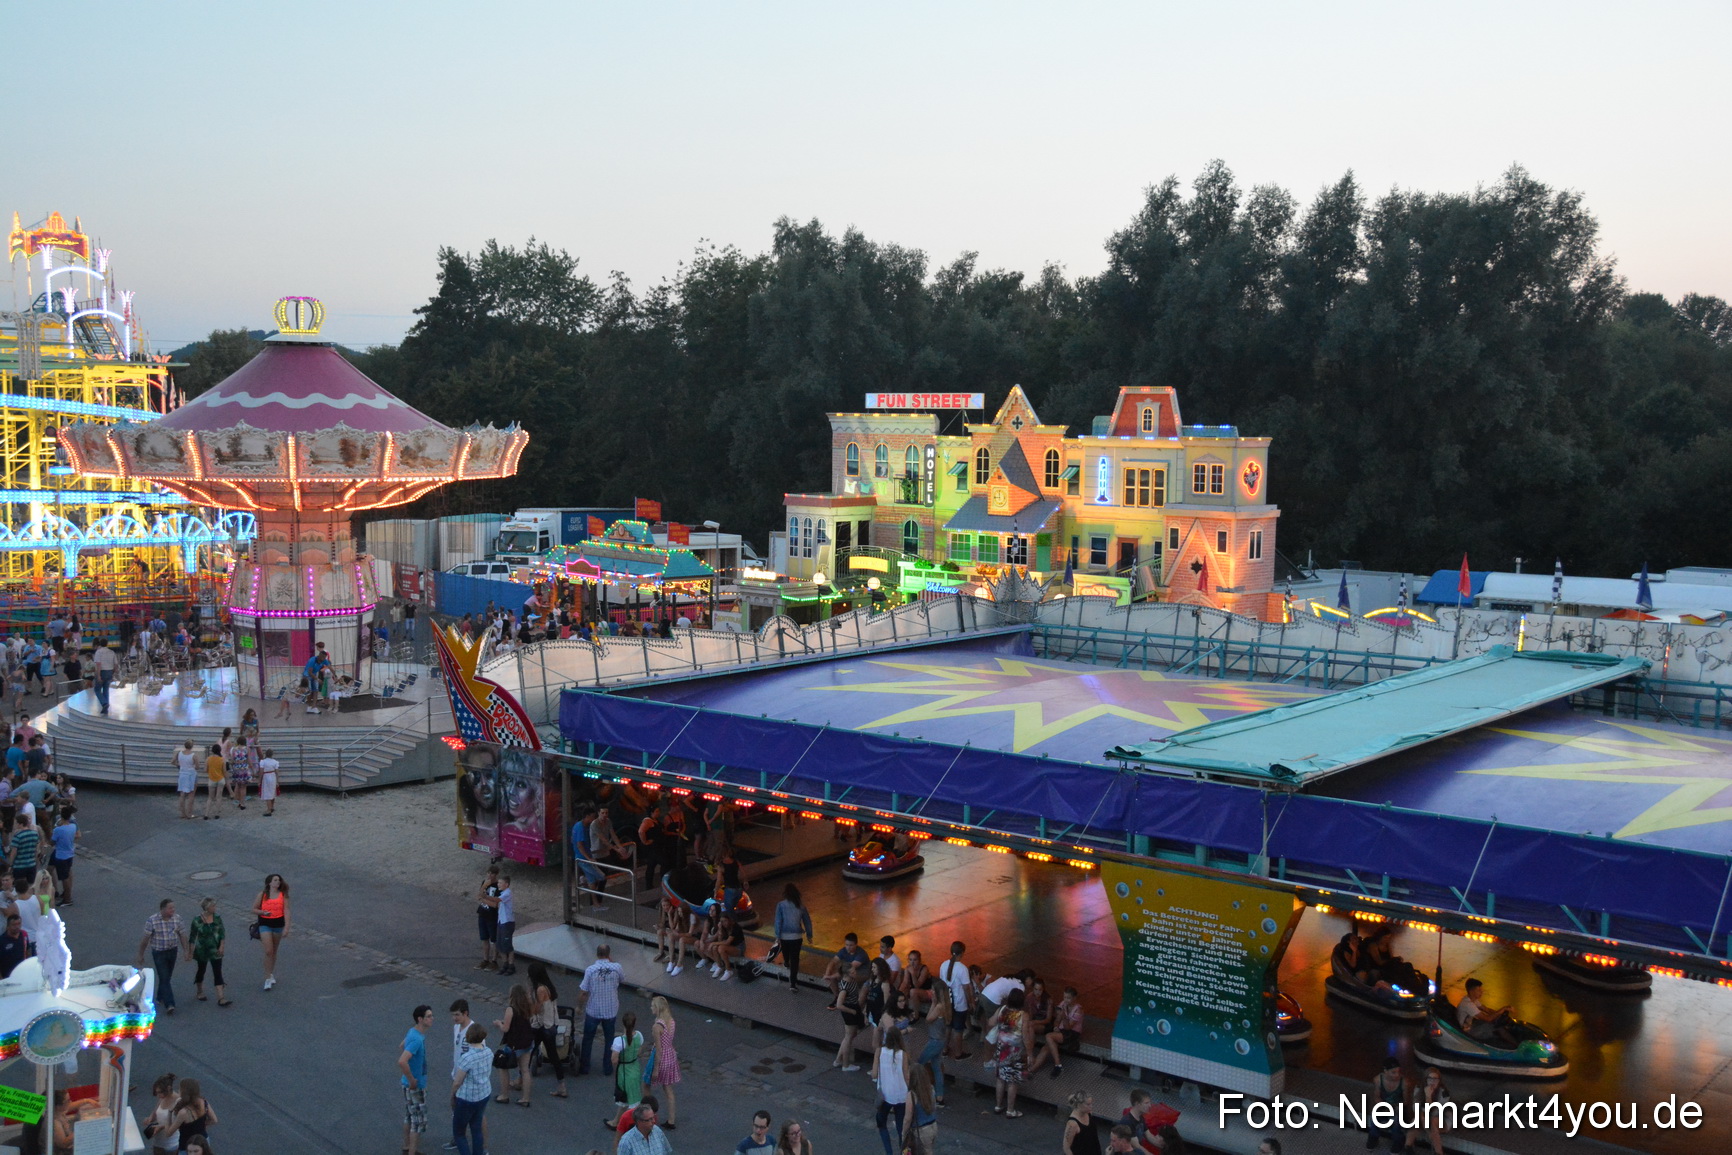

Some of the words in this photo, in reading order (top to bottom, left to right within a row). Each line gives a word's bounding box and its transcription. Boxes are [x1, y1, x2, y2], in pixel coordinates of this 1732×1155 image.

[877, 394, 906, 408] FUN
[912, 394, 972, 408] STREET
[926, 448, 934, 503] HOTEL
[926, 582, 959, 594] Welcome
[1142, 909, 1158, 917] Das
[1160, 912, 1200, 925] Betreten
[1220, 924, 1244, 932] Fahr-
[1168, 906, 1219, 920] ACHTUNG!
[1144, 922, 1174, 932] Kinder
[1176, 930, 1201, 938] unter
[1212, 936, 1242, 947] Jahren
[1152, 918, 1174, 926] bahn
[1188, 926, 1234, 938] verboten!
[1138, 928, 1168, 938] dürfen
[1199, 940, 1248, 956] Begleitung
[1146, 936, 1203, 952] Erwachsener
[1224, 952, 1241, 960] mit
[1138, 954, 1154, 962] Das
[1156, 958, 1226, 978] Herausstrecken
[1139, 942, 1187, 956] angelegten
[1190, 951, 1246, 967] Sicherheits-
[1158, 952, 1188, 962] gurten
[1190, 959, 1222, 970] fahren.
[1134, 960, 1165, 971] Armen
[1186, 971, 1220, 984] Beinen,
[1222, 980, 1249, 990] sowie
[1154, 971, 1196, 985] Schirmen
[1209, 982, 1246, 996] Stöcken
[1136, 980, 1160, 990] Keine
[1162, 986, 1199, 1000] Haftung
[1216, 998, 1248, 1009] selbst-
[1144, 988, 1200, 1006] verschuldete
[1202, 1001, 1238, 1014] Unfälle.
[1175, 983, 1219, 997] verboten.
